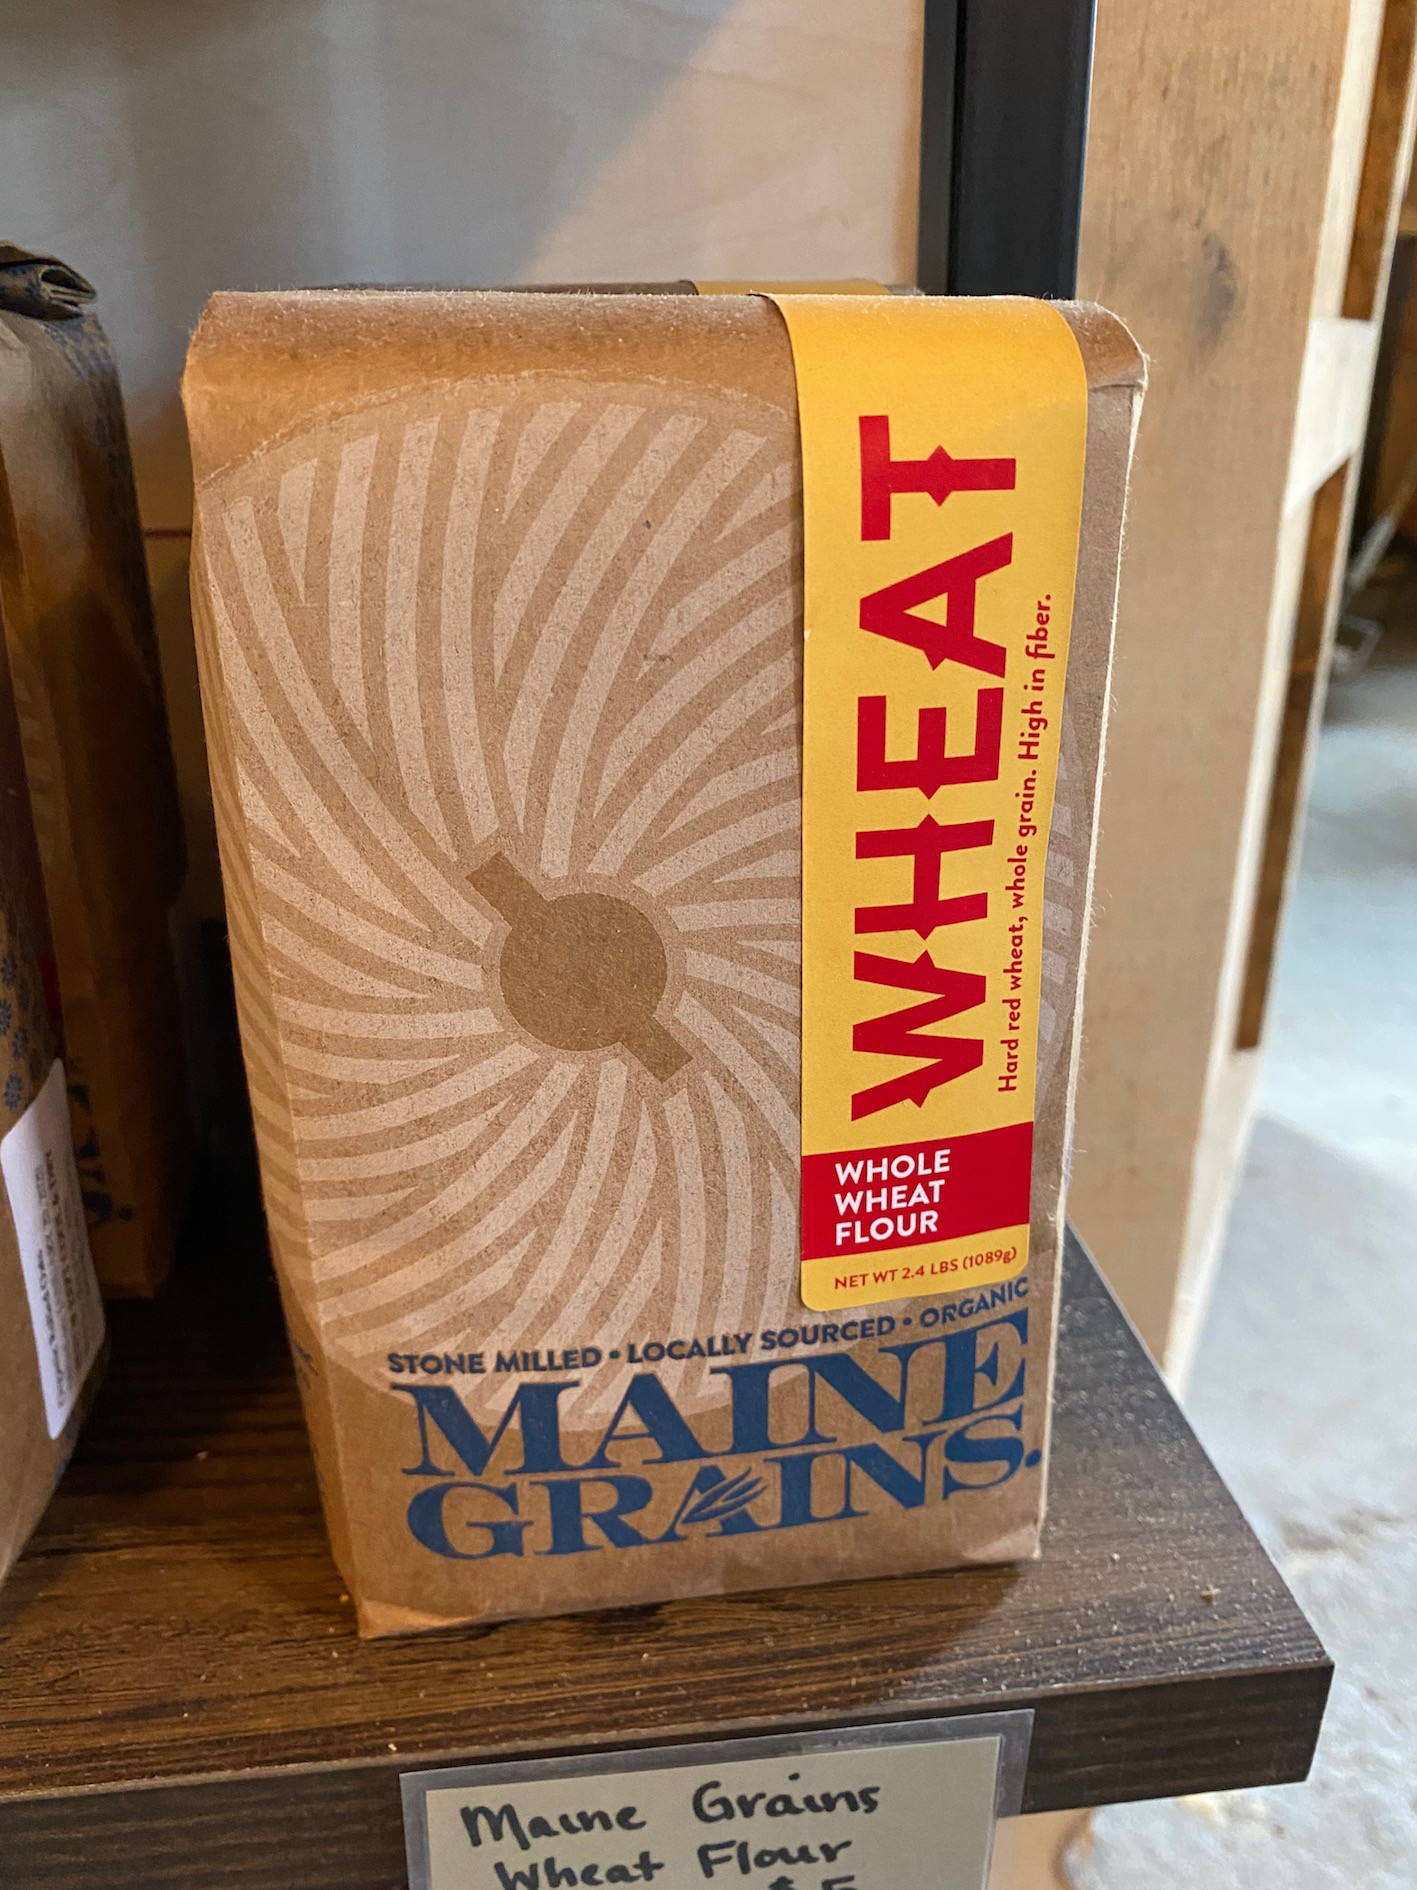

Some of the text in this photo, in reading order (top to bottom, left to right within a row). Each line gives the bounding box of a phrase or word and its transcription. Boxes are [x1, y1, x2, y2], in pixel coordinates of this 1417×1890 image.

[851, 415, 1015, 1121] WHEAT
[998, 594, 1055, 1092] Hard red wheat, whole grain. High in fiber.
[834, 1149, 951, 1187] WHOLE
[834, 1179, 946, 1217] WHEAT
[835, 1210, 939, 1247] FLOUR
[834, 1246, 1018, 1290] NET WT 2.4 LBS (1089g)
[388, 1276, 1029, 1375] STONE MILLED LOCALLY SOURCED ORGANIC
[390, 1307, 1029, 1477] MAINE
[461, 1772, 881, 1850] Maine Grains
[494, 1839, 852, 1890] Wheat Flour
